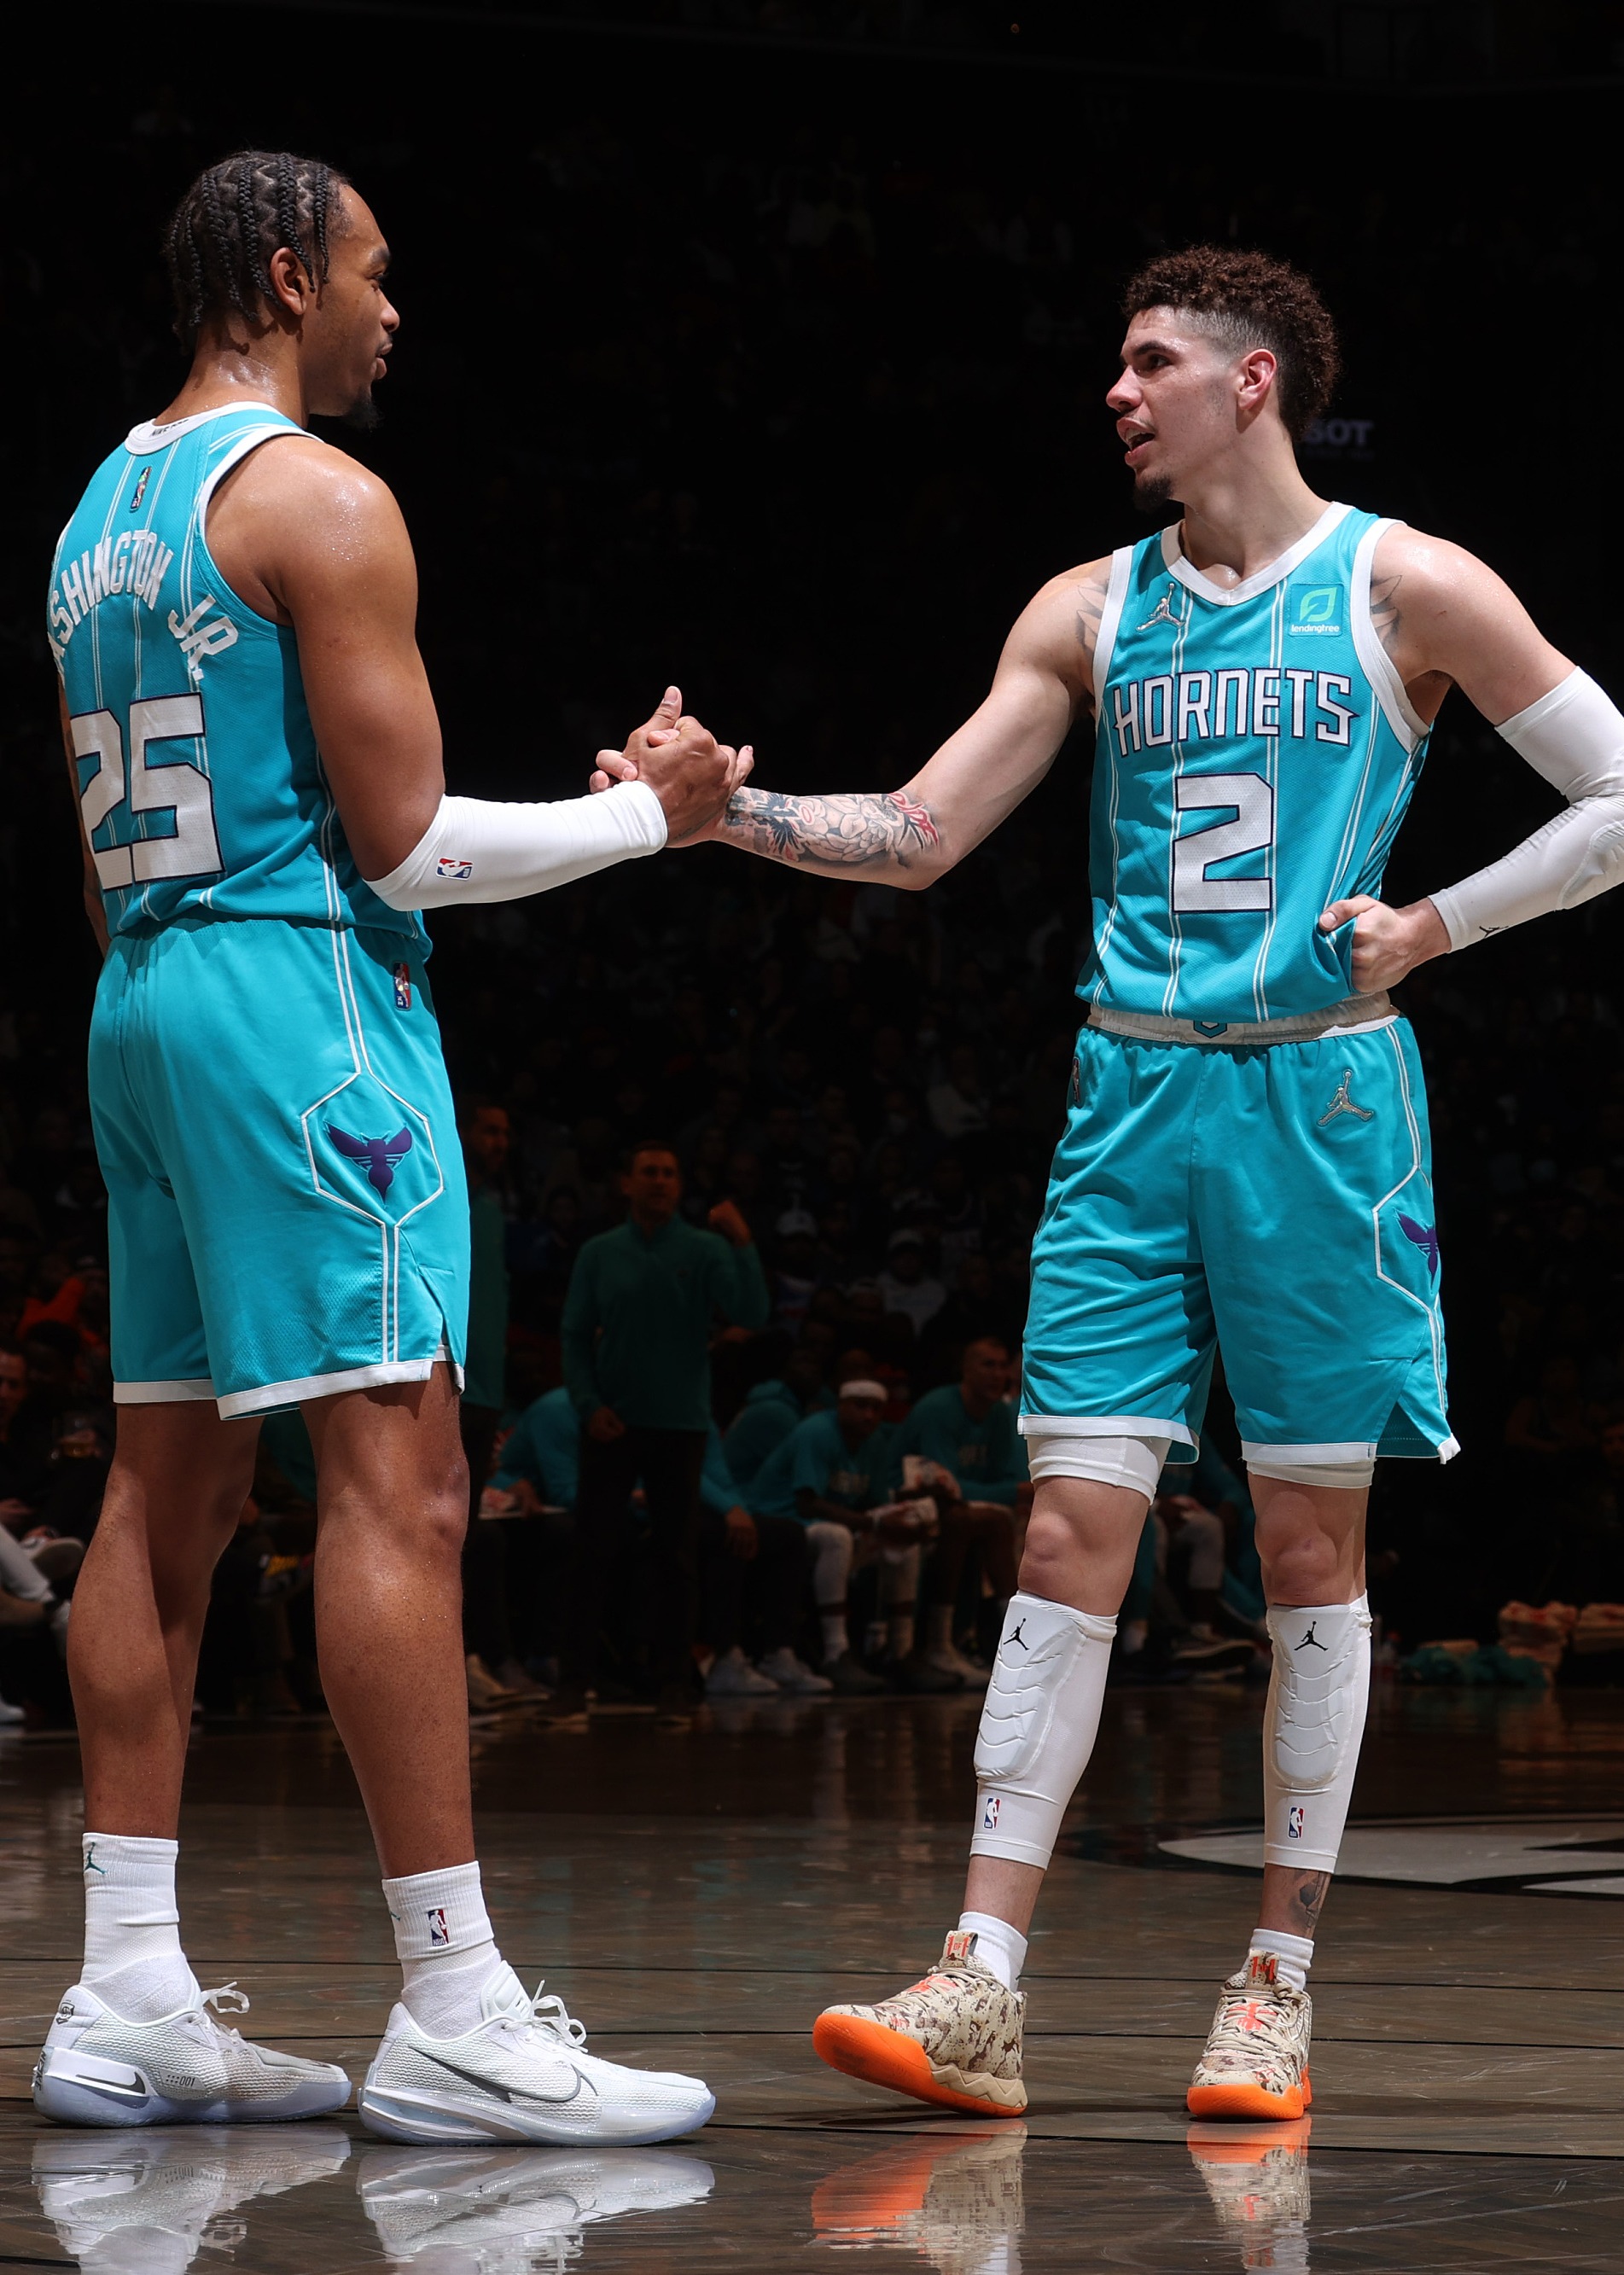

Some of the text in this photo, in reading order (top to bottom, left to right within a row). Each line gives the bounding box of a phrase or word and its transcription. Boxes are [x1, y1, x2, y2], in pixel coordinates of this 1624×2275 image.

[1291, 624, 1340, 634] lendingtree
[1113, 667, 1360, 757] HORNETS
[70, 691, 226, 892] 25
[1172, 771, 1274, 913] 2
